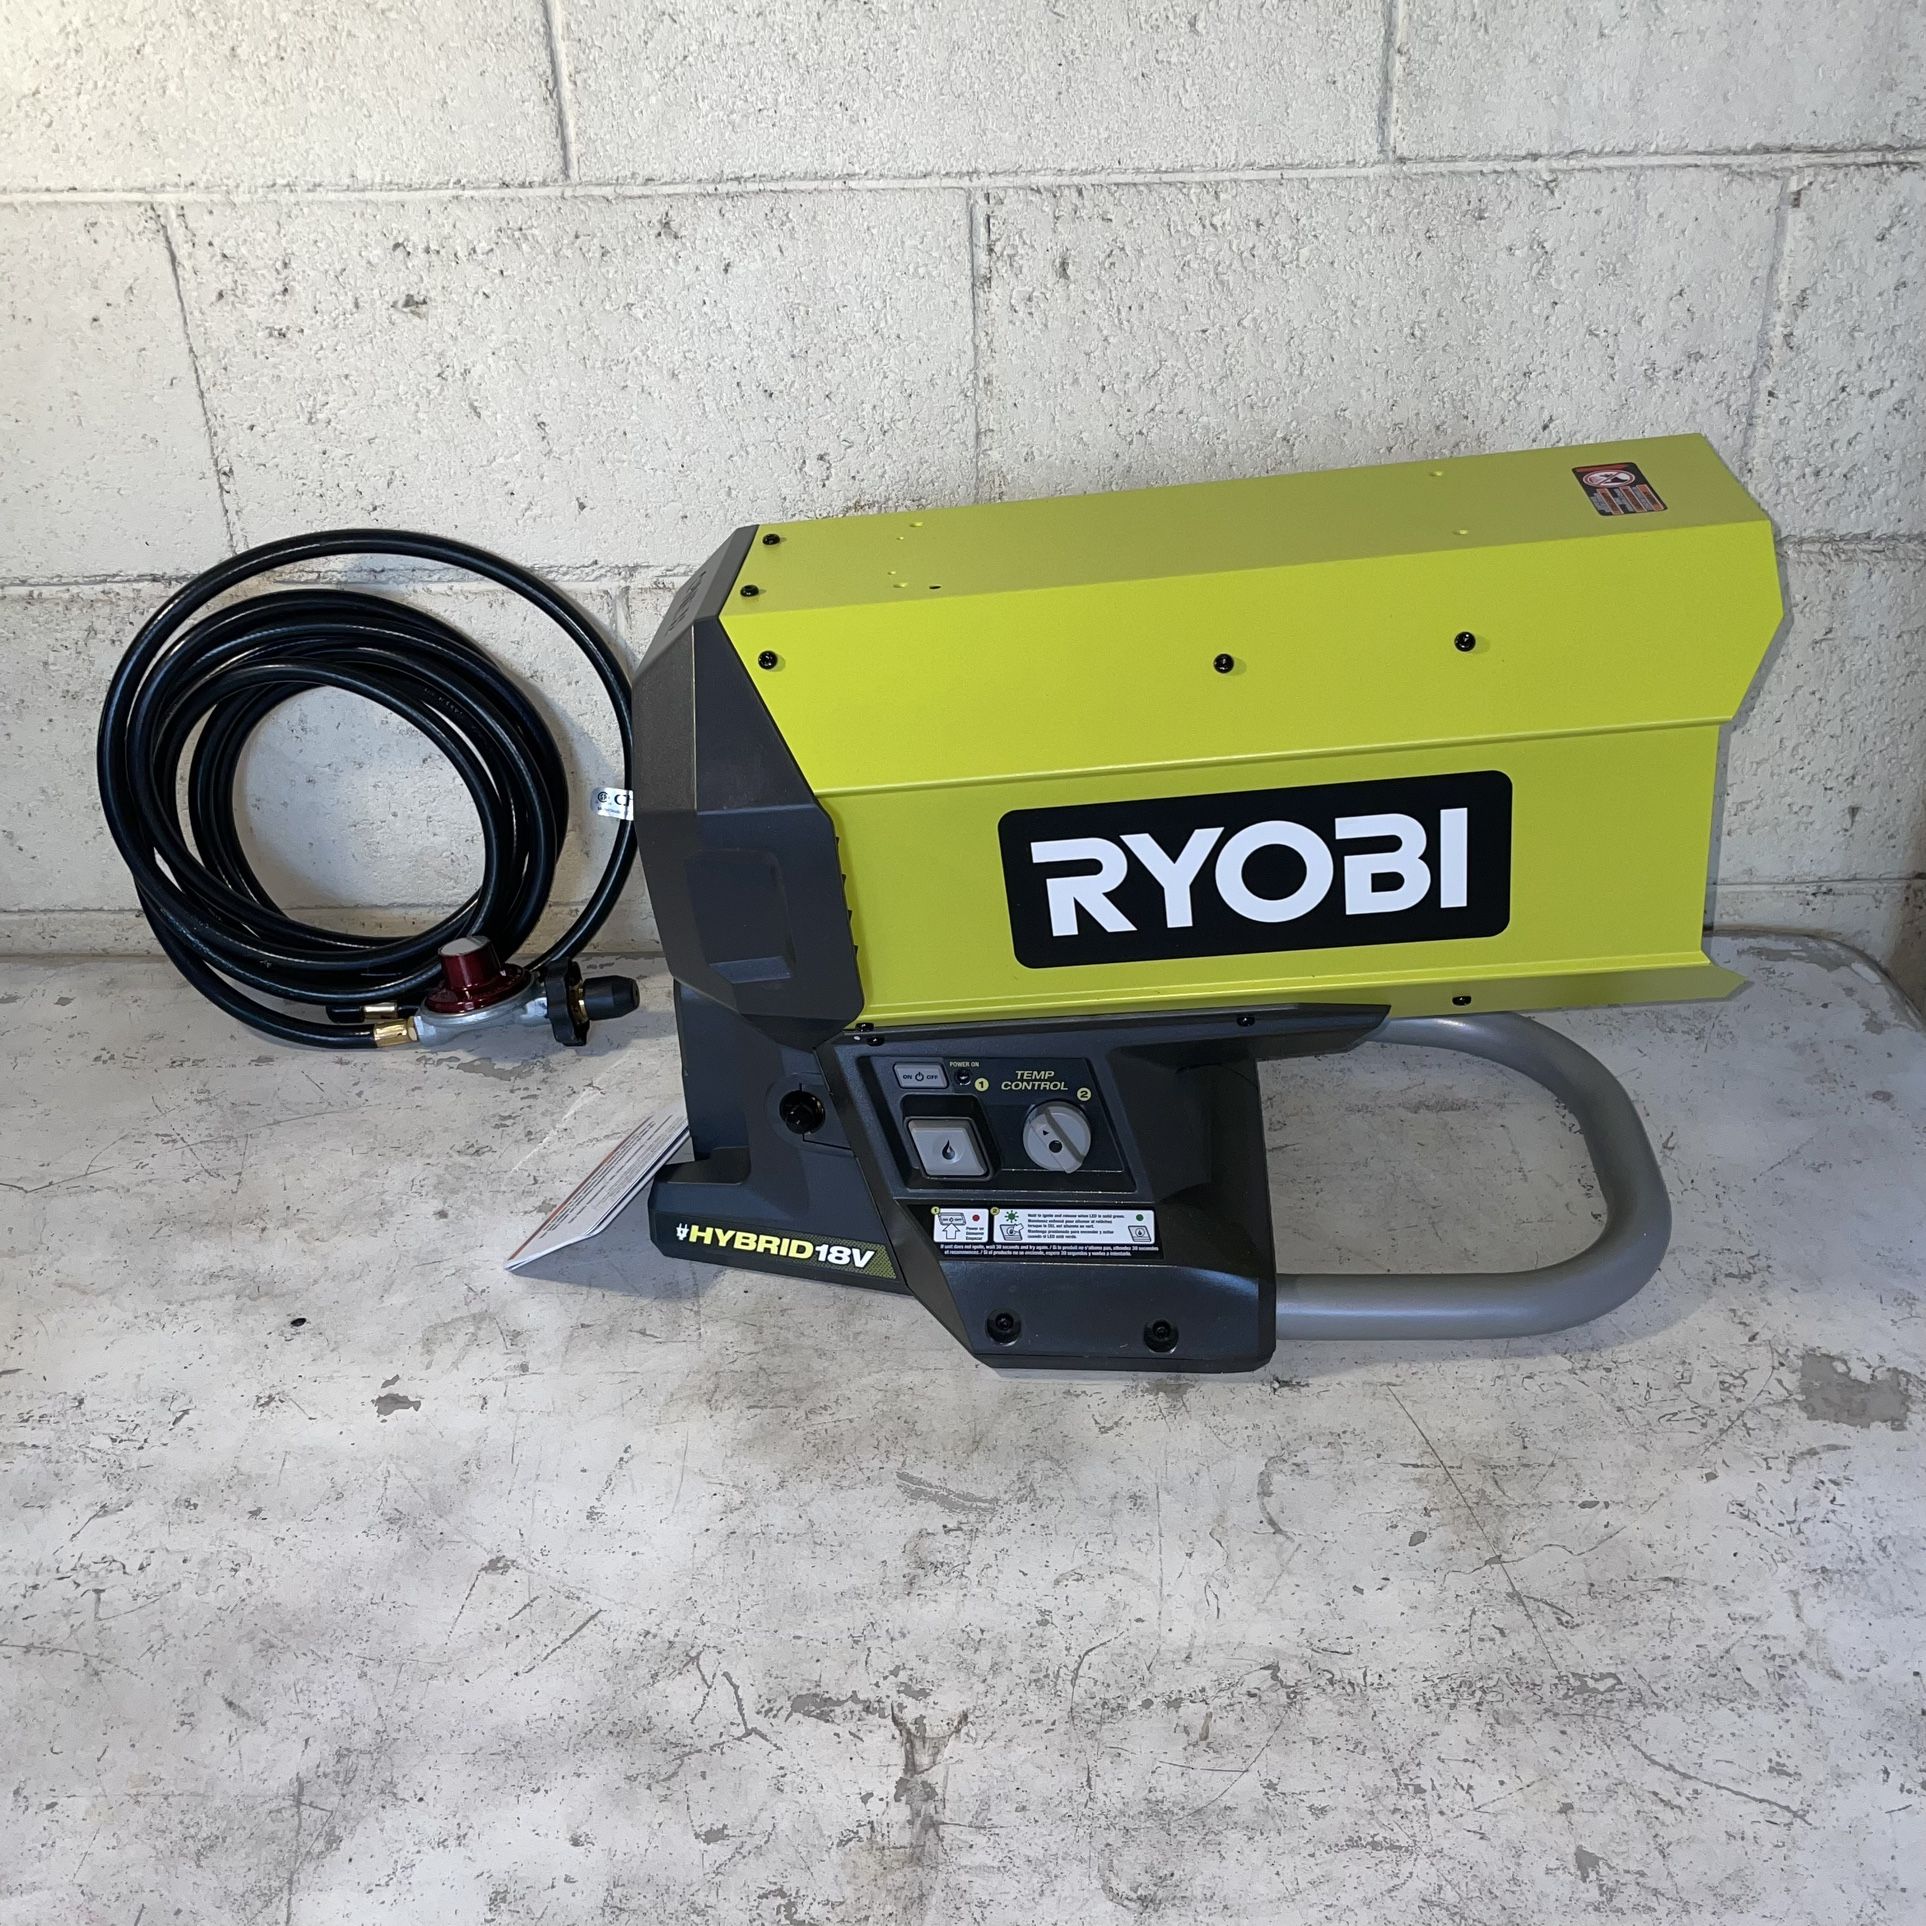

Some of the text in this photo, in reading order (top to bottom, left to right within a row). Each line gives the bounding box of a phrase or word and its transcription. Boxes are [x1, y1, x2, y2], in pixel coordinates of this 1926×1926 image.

[1030, 807, 1468, 937] RYOBI
[1015, 1070, 1055, 1080] TEMP
[1001, 1081, 1069, 1091] CONTROL
[1080, 1090, 1089, 1099] 2
